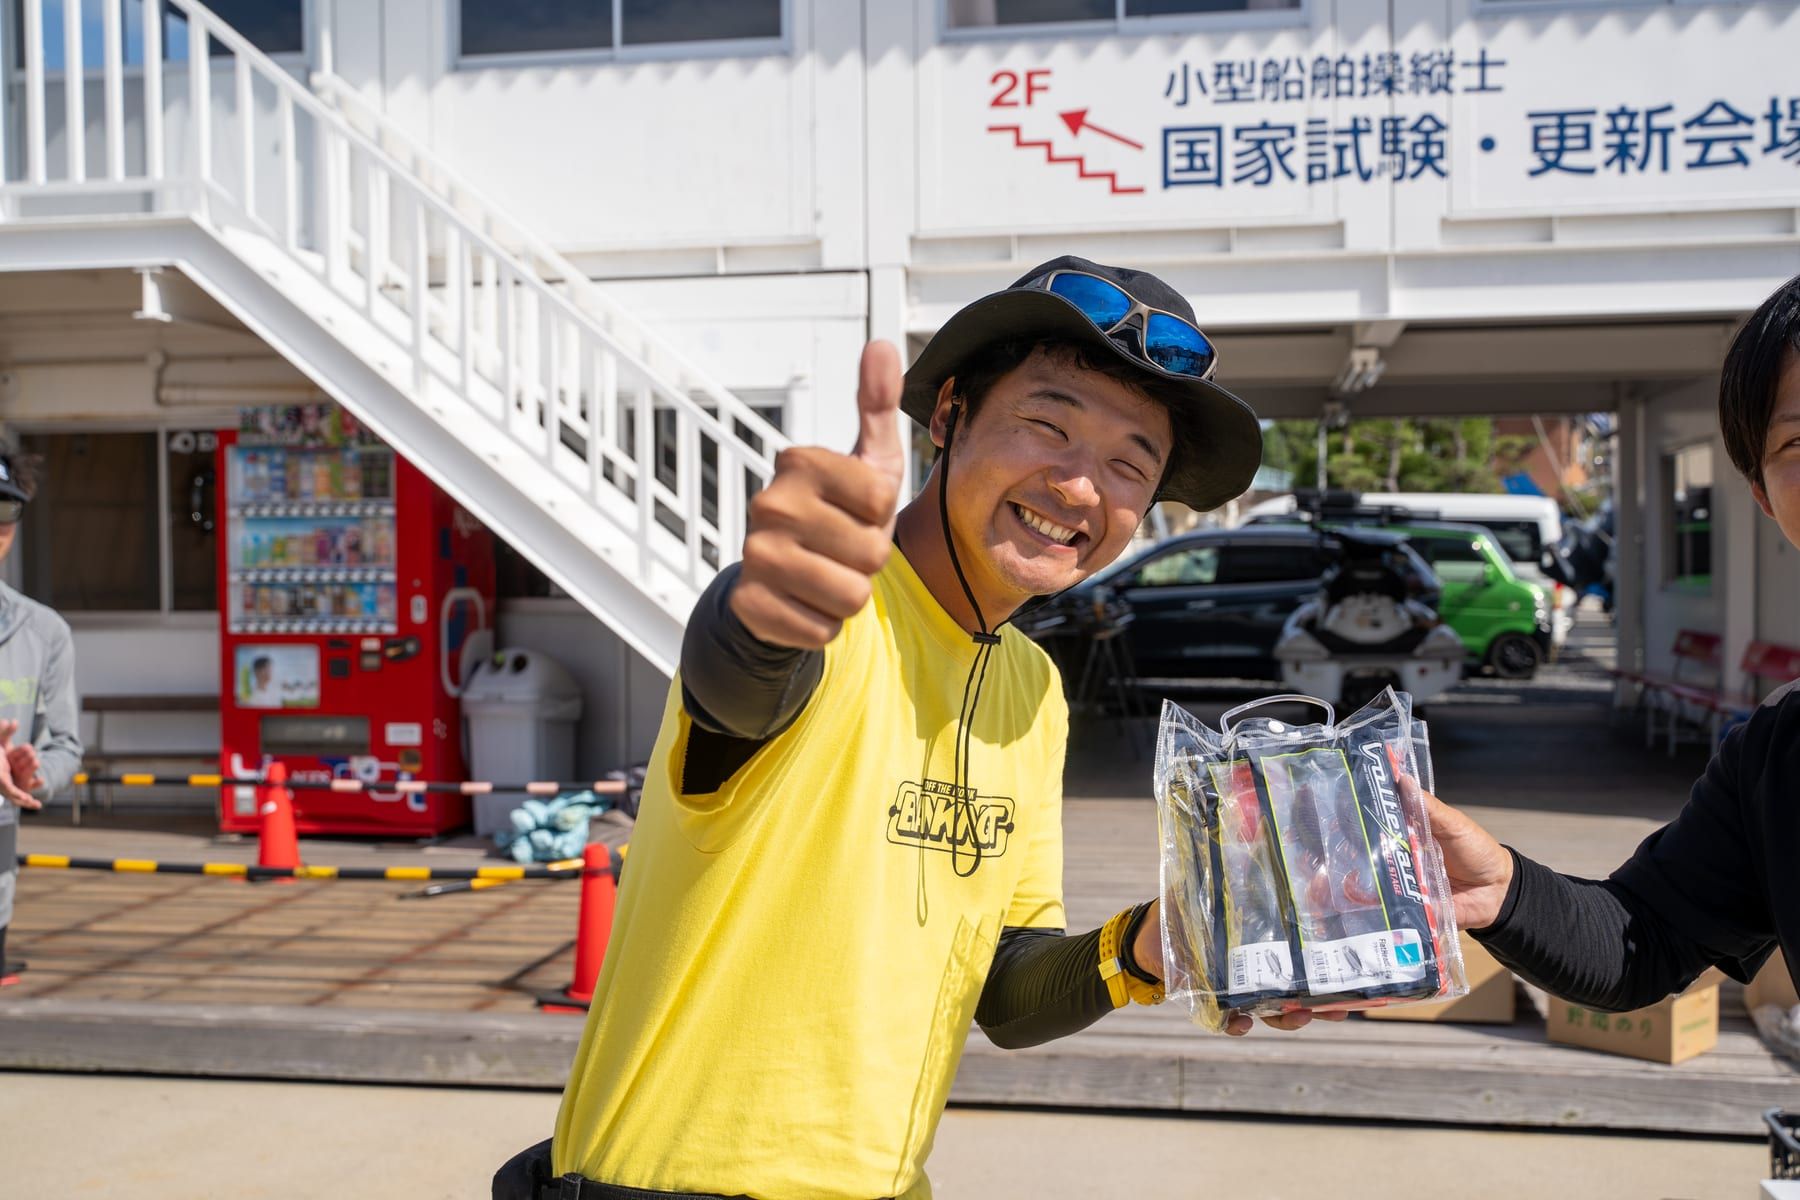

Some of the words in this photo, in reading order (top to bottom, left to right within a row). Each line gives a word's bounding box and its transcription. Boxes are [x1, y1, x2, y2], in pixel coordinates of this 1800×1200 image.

[990, 69, 1052, 108] 2F
[1164, 49, 1507, 107] 小型船舶操縦士
[937, 783, 952, 795] THE
